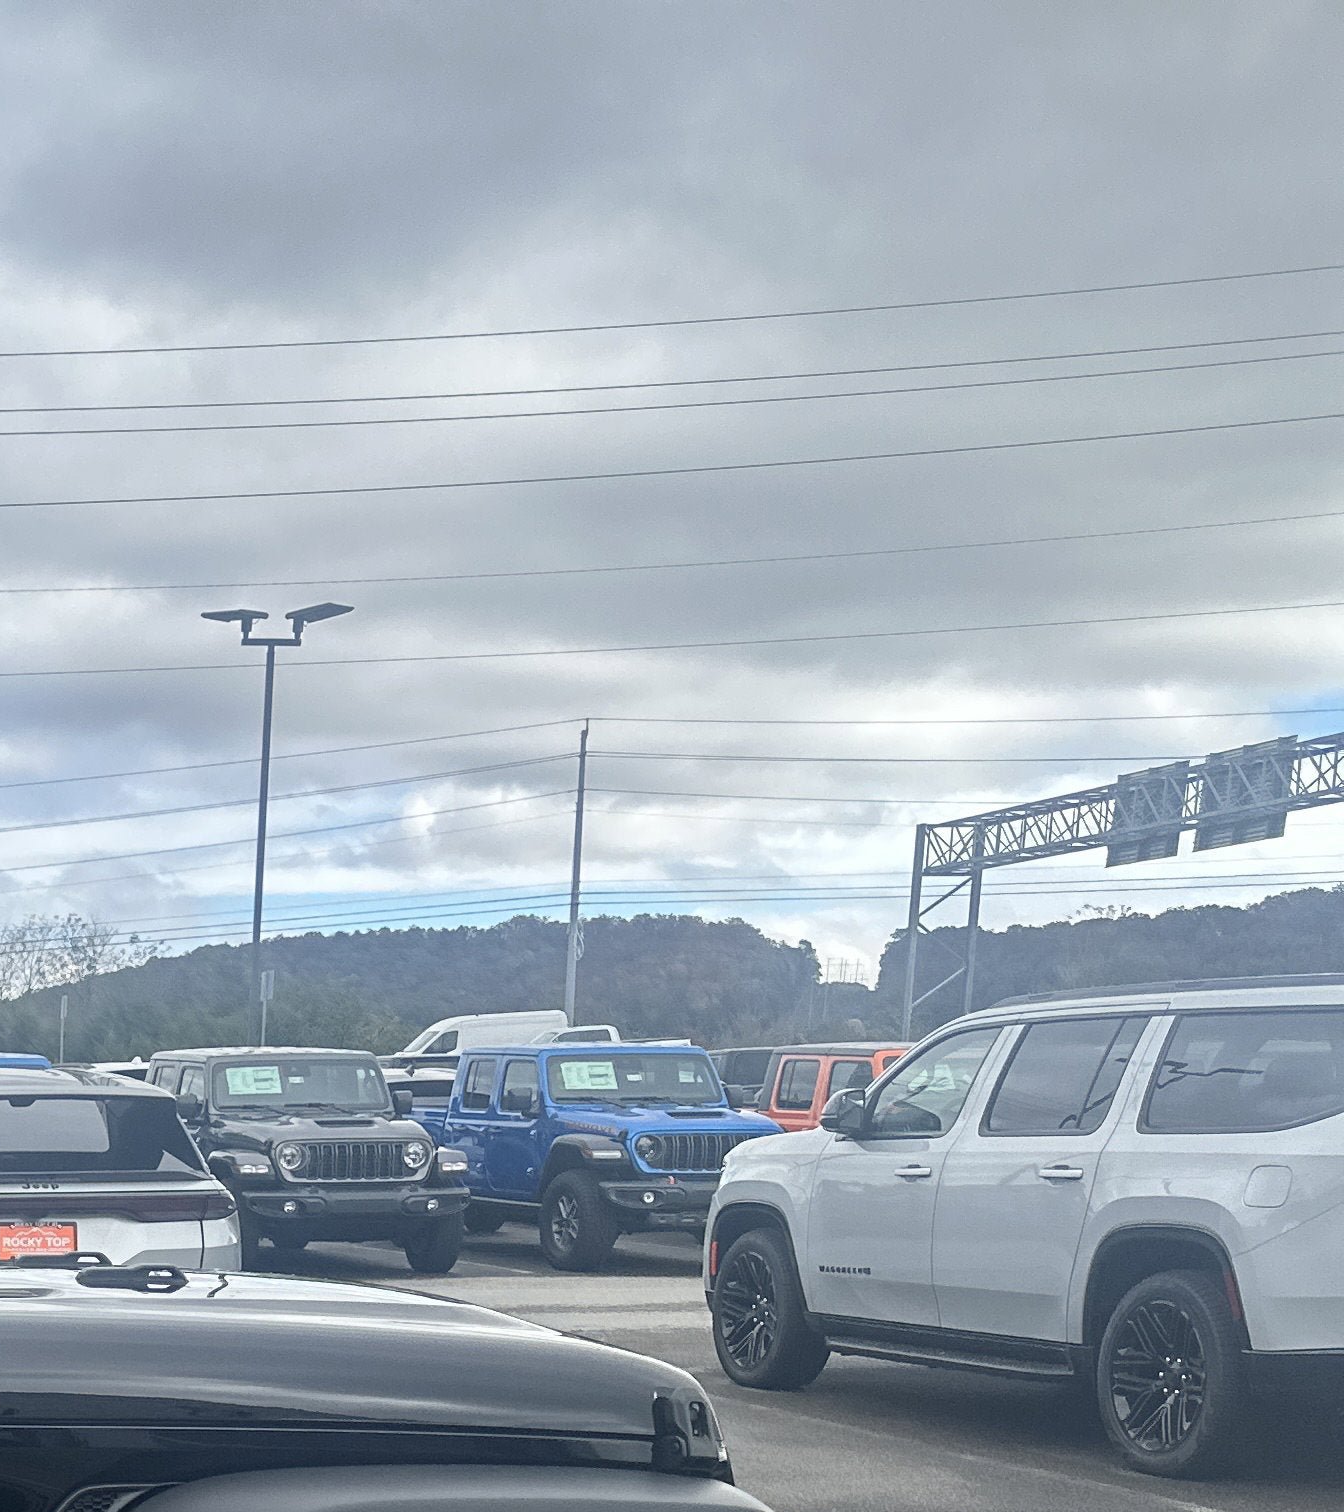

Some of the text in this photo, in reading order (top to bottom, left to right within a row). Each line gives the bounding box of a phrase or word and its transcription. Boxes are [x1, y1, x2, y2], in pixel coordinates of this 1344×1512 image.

[21, 1182, 60, 1190] Jeep
[2, 1236, 71, 1248] ROCKY TOP
